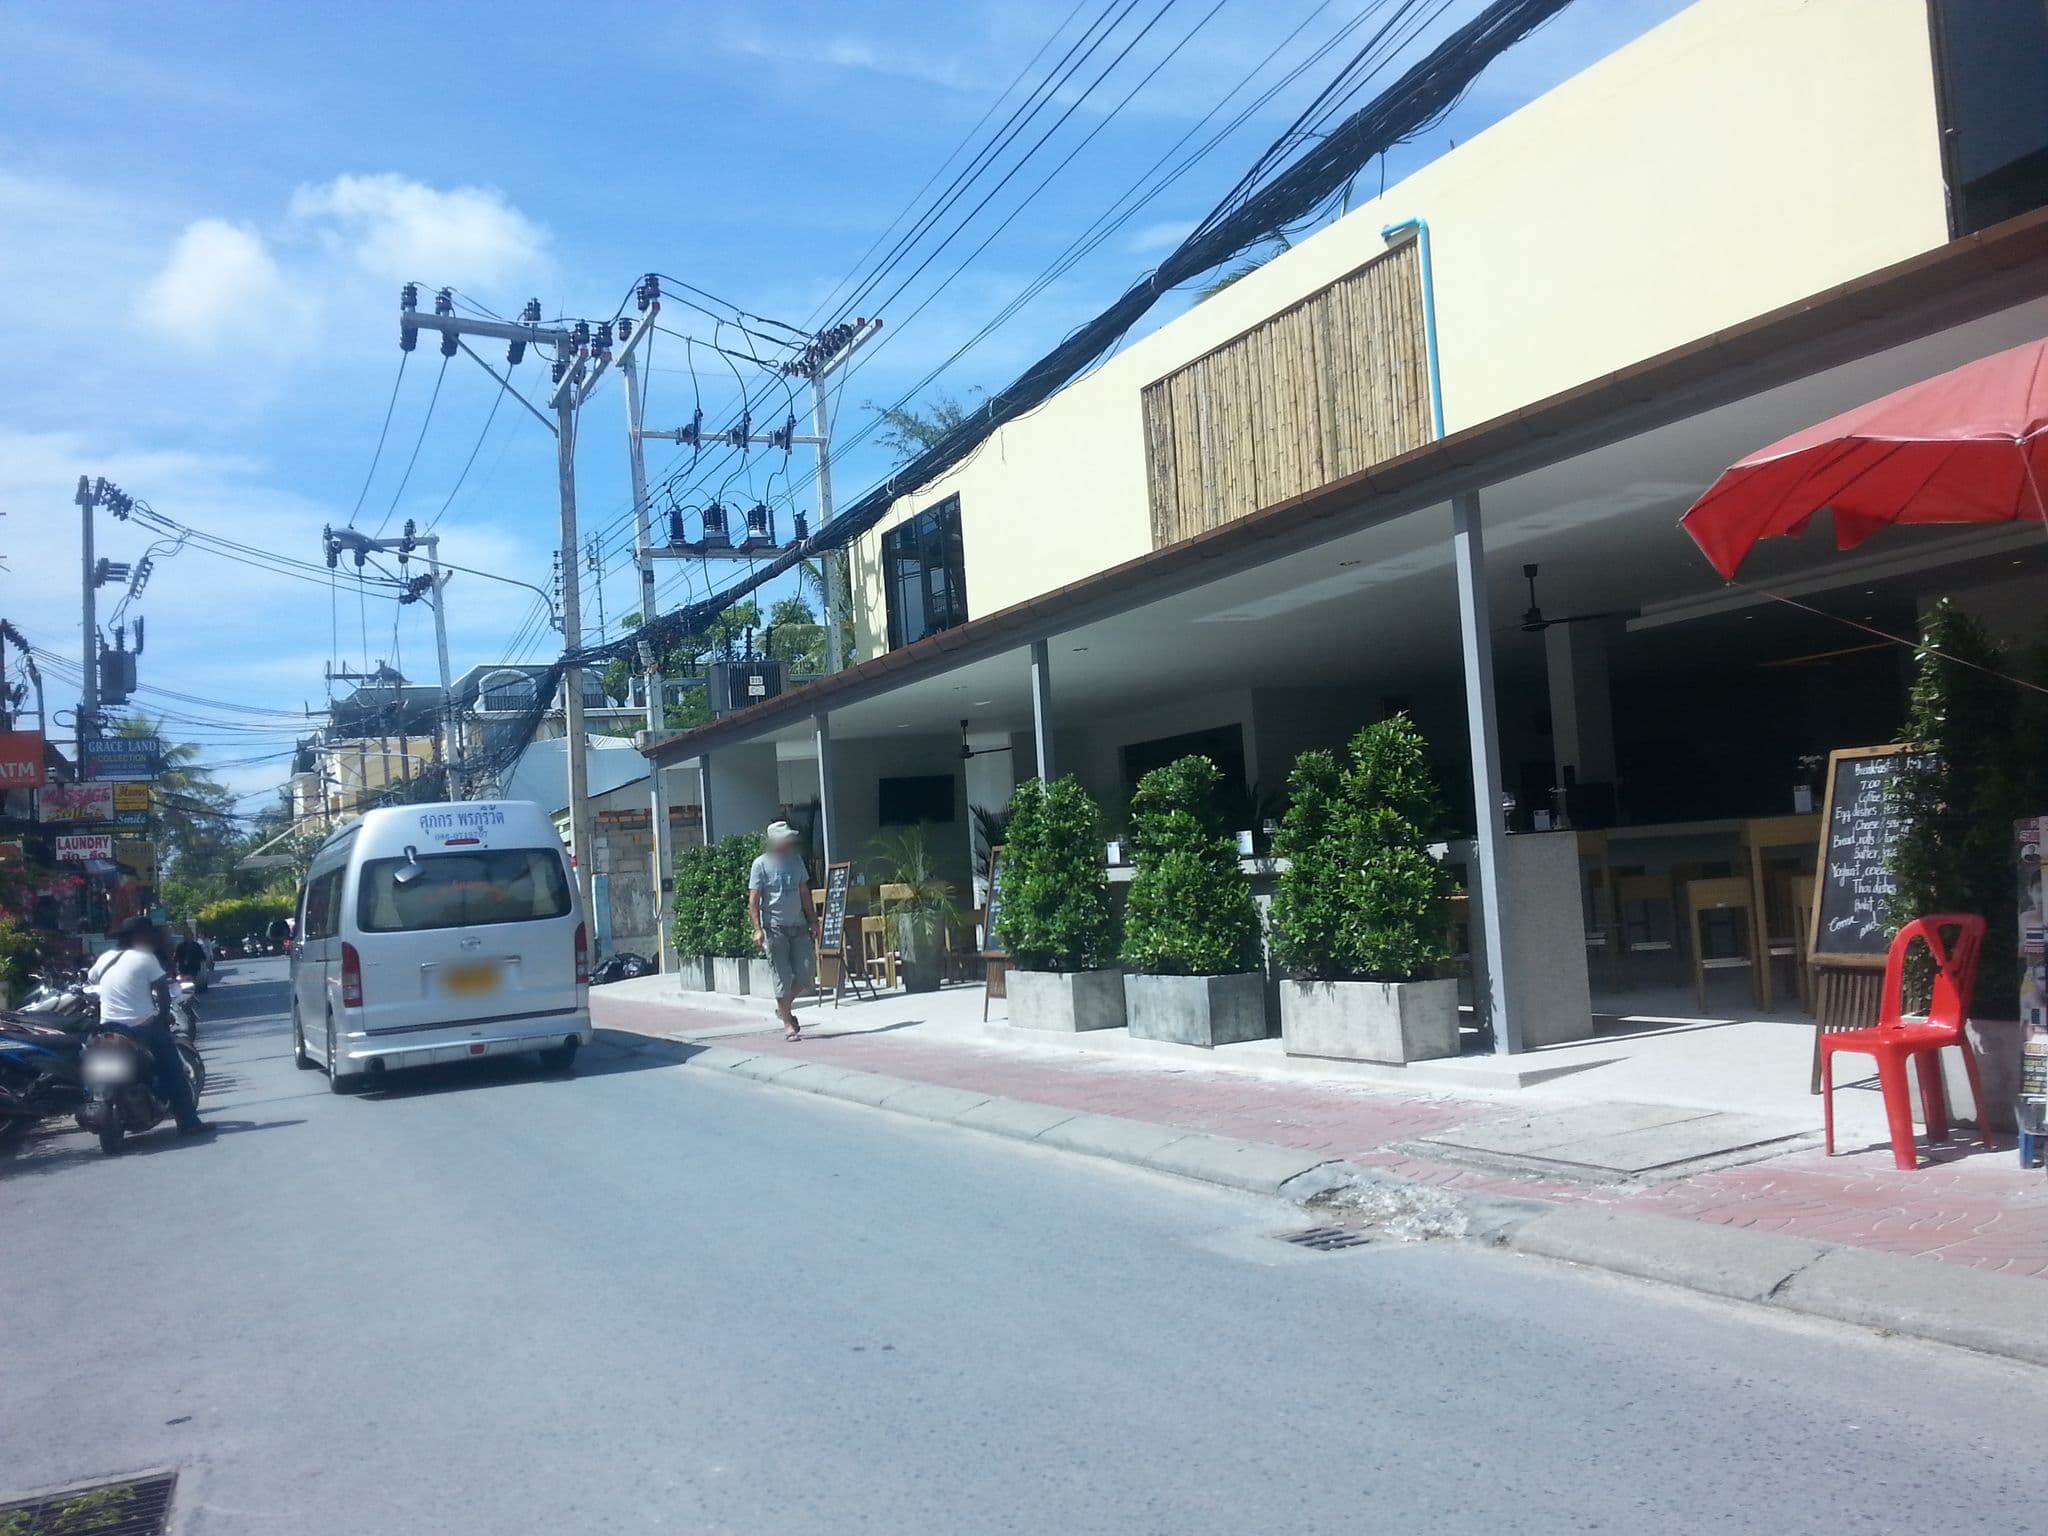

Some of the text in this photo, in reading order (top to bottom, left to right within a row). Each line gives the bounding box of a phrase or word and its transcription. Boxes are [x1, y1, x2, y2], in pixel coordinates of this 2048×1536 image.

[88, 740, 157, 753] GRACE LAND
[117, 813, 147, 825] Smile
[1835, 806, 1851, 825] Egg
[57, 836, 110, 851] LAUNDRY
[1852, 878, 1871, 894] Thai
